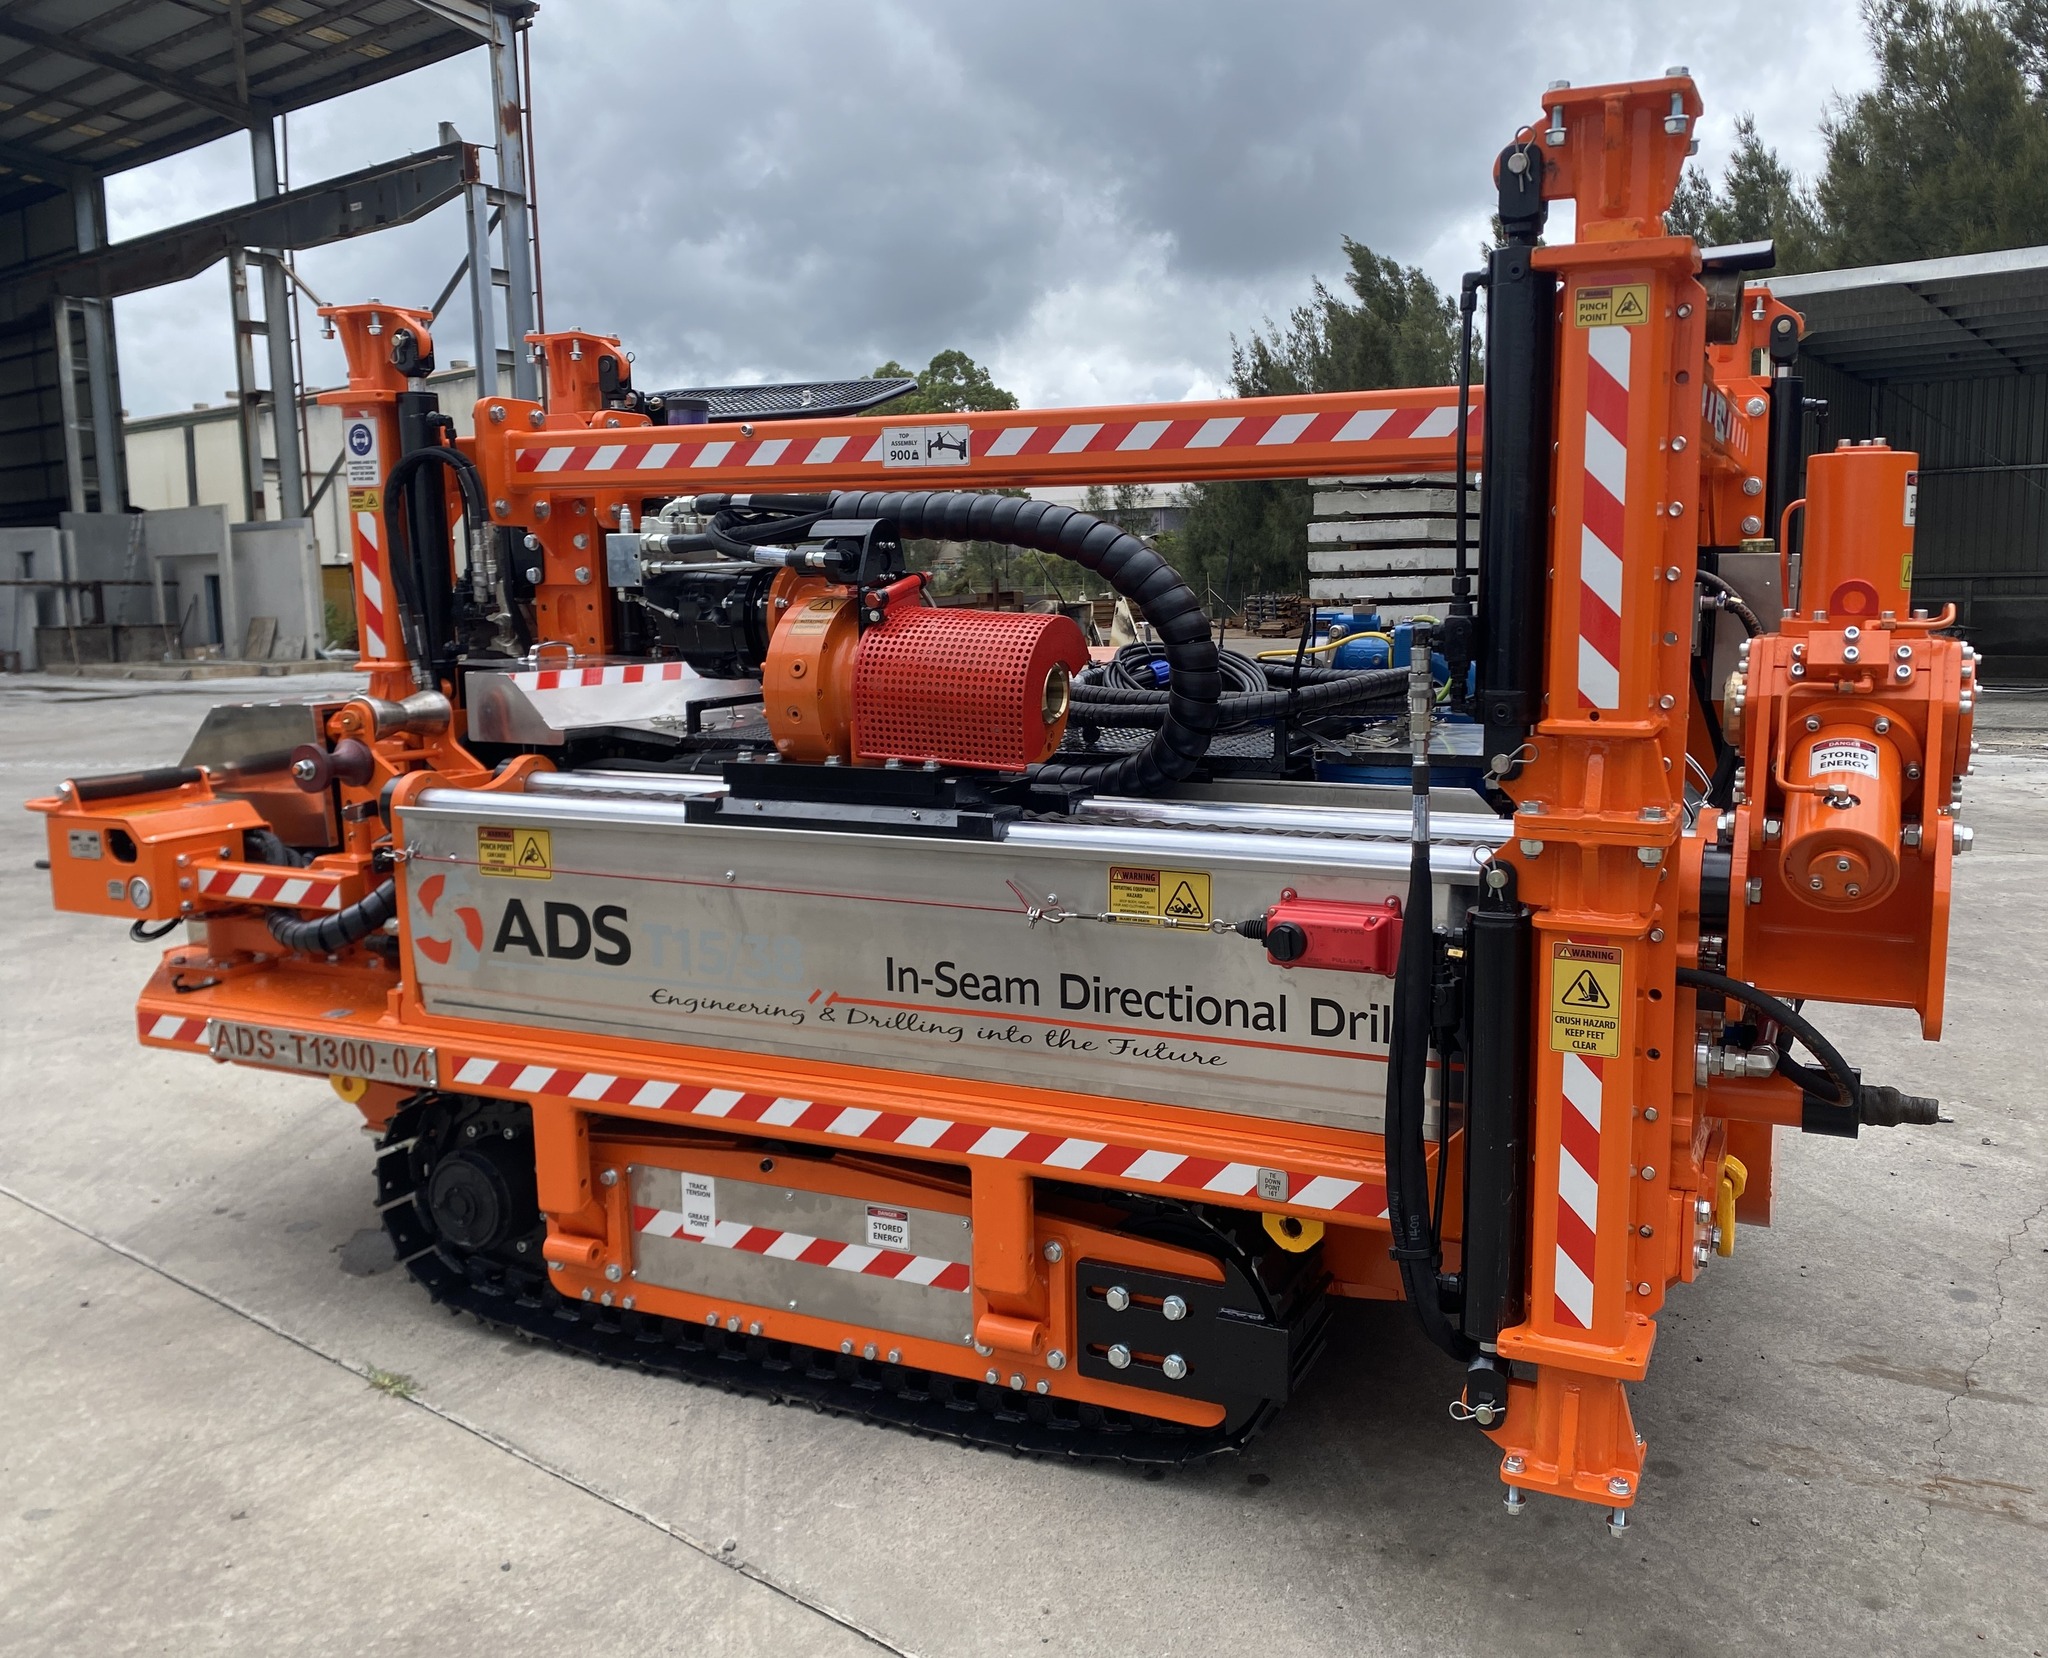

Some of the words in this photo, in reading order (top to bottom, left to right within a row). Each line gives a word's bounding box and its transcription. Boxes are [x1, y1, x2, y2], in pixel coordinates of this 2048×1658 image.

[1580, 302, 1608, 311] PINCH
[1580, 313, 1608, 322] POINT
[890, 449, 911, 461] 900
[1820, 751, 1869, 761] STORED
[1820, 760, 1869, 769] ENERGY
[1122, 872, 1156, 881] WARNING
[493, 898, 632, 967] ADS
[1572, 949, 1614, 960] WARNING
[885, 956, 1041, 1008] In-Seam
[1059, 972, 1287, 1034] Directional
[1555, 1016, 1581, 1026] CRUSH
[1583, 1019, 1616, 1029] HAZARD
[649, 988, 806, 1025] Engineering
[819, 1005, 837, 1024] &
[846, 1006, 964, 1043] Drilling
[976, 1022, 1033, 1046] into
[1046, 1026, 1099, 1053] the
[1107, 1036, 1228, 1068] Future
[1565, 1028, 1585, 1038] KEEP
[1586, 1031, 1605, 1040] FEET
[1572, 1040, 1597, 1050] CLEAR
[689, 1182, 707, 1190] TRACK
[686, 1189, 711, 1198] TENSION
[688, 1213, 710, 1221] GREASE
[690, 1219, 708, 1227] POINT
[873, 1222, 903, 1233] STORED
[873, 1232, 903, 1243] ENERGY
